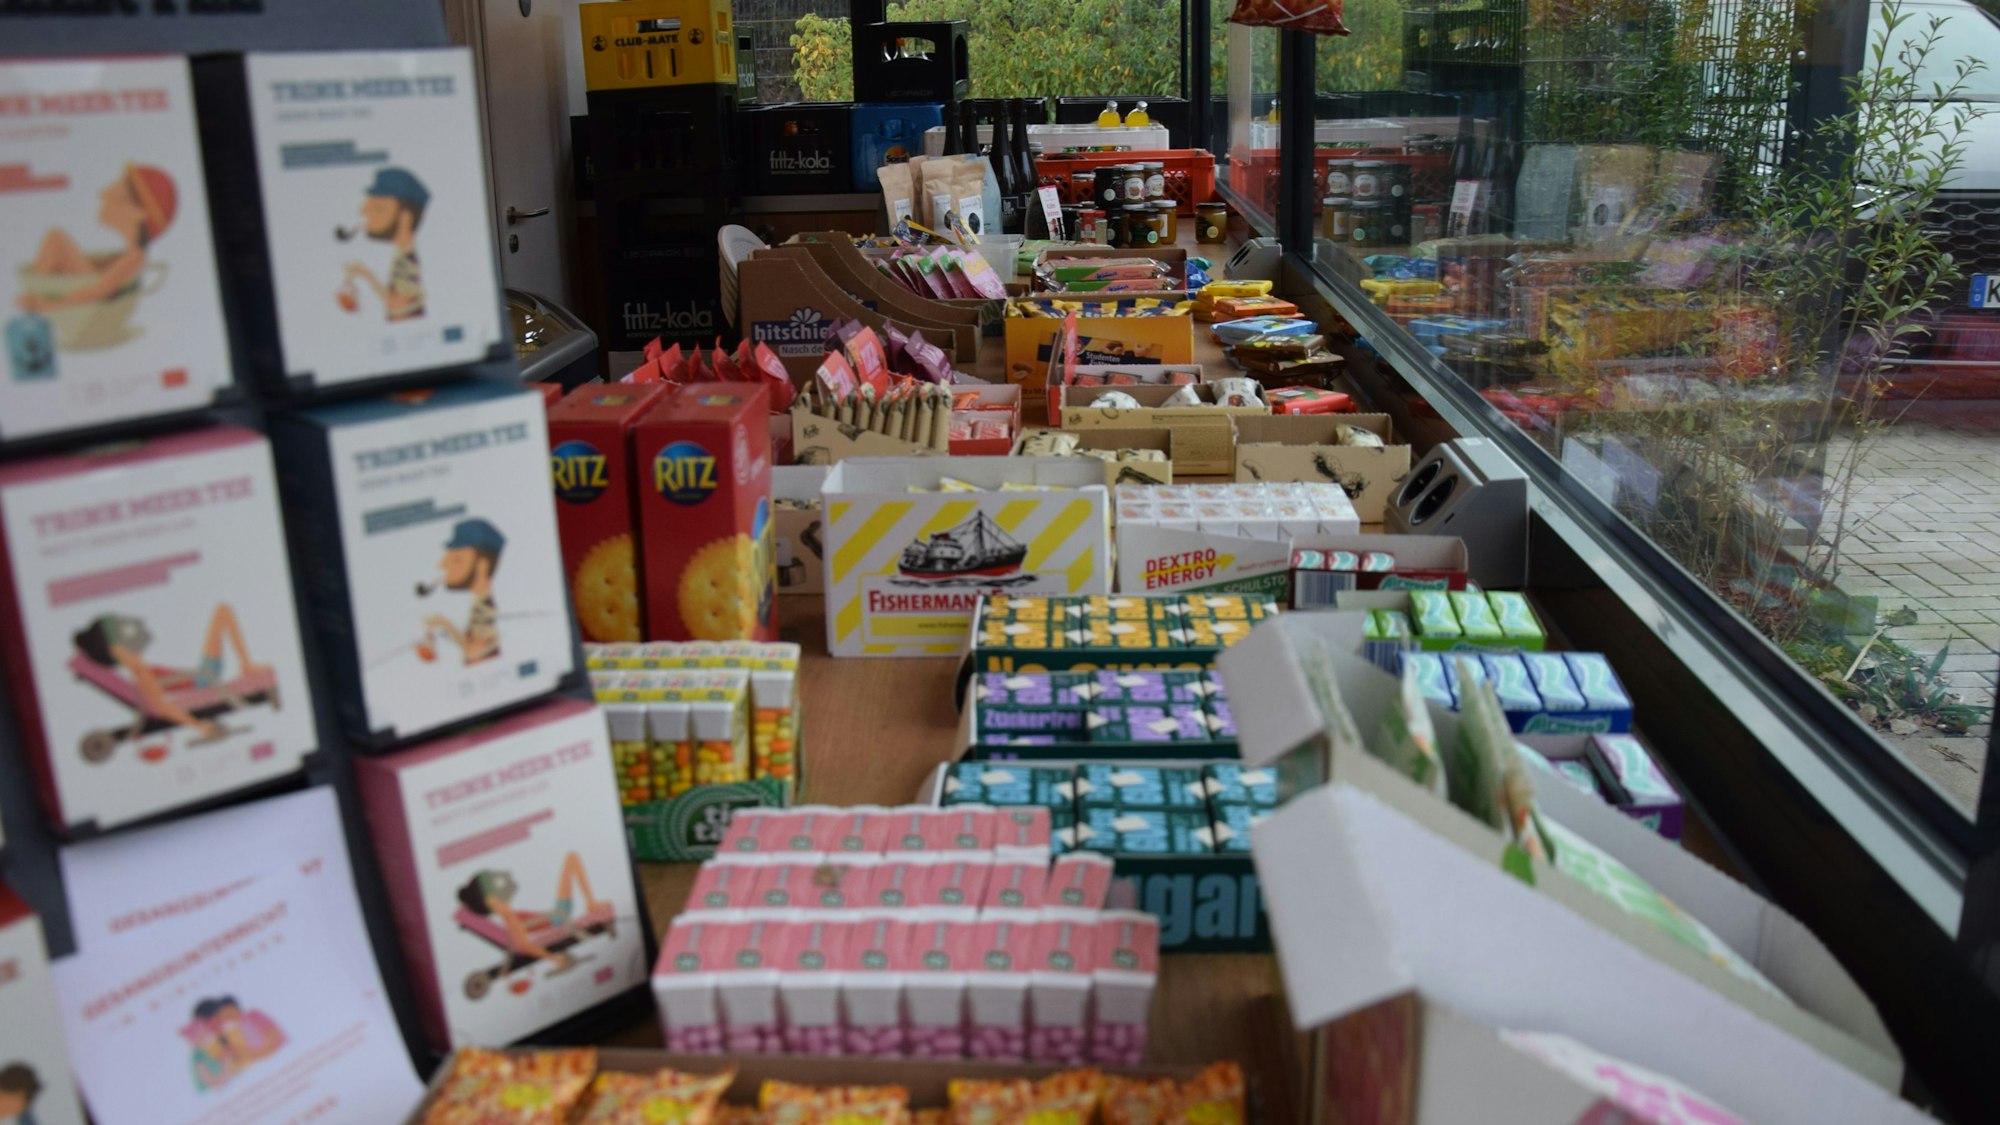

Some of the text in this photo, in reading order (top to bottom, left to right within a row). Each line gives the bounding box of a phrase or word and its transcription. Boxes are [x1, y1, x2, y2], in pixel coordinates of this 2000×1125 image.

[615, 33, 679, 47] CLUB-MATE
[769, 150, 831, 170] fritz-kola
[622, 301, 714, 330] fritz-kola
[754, 324, 830, 341] hitschie
[781, 344, 824, 355] Nasch de
[1085, 352, 1120, 363] Studenten
[551, 454, 609, 491] RITZ
[653, 455, 718, 493] RITZ
[1145, 548, 1217, 573] DEXTRO
[1145, 564, 1217, 590] ENERGY
[1224, 575, 1287, 593] SCHULSTO
[868, 589, 982, 613] FISHERMAN'
[703, 802, 732, 824] ti
[693, 824, 729, 842] ta
[1117, 873, 1267, 946] gar
